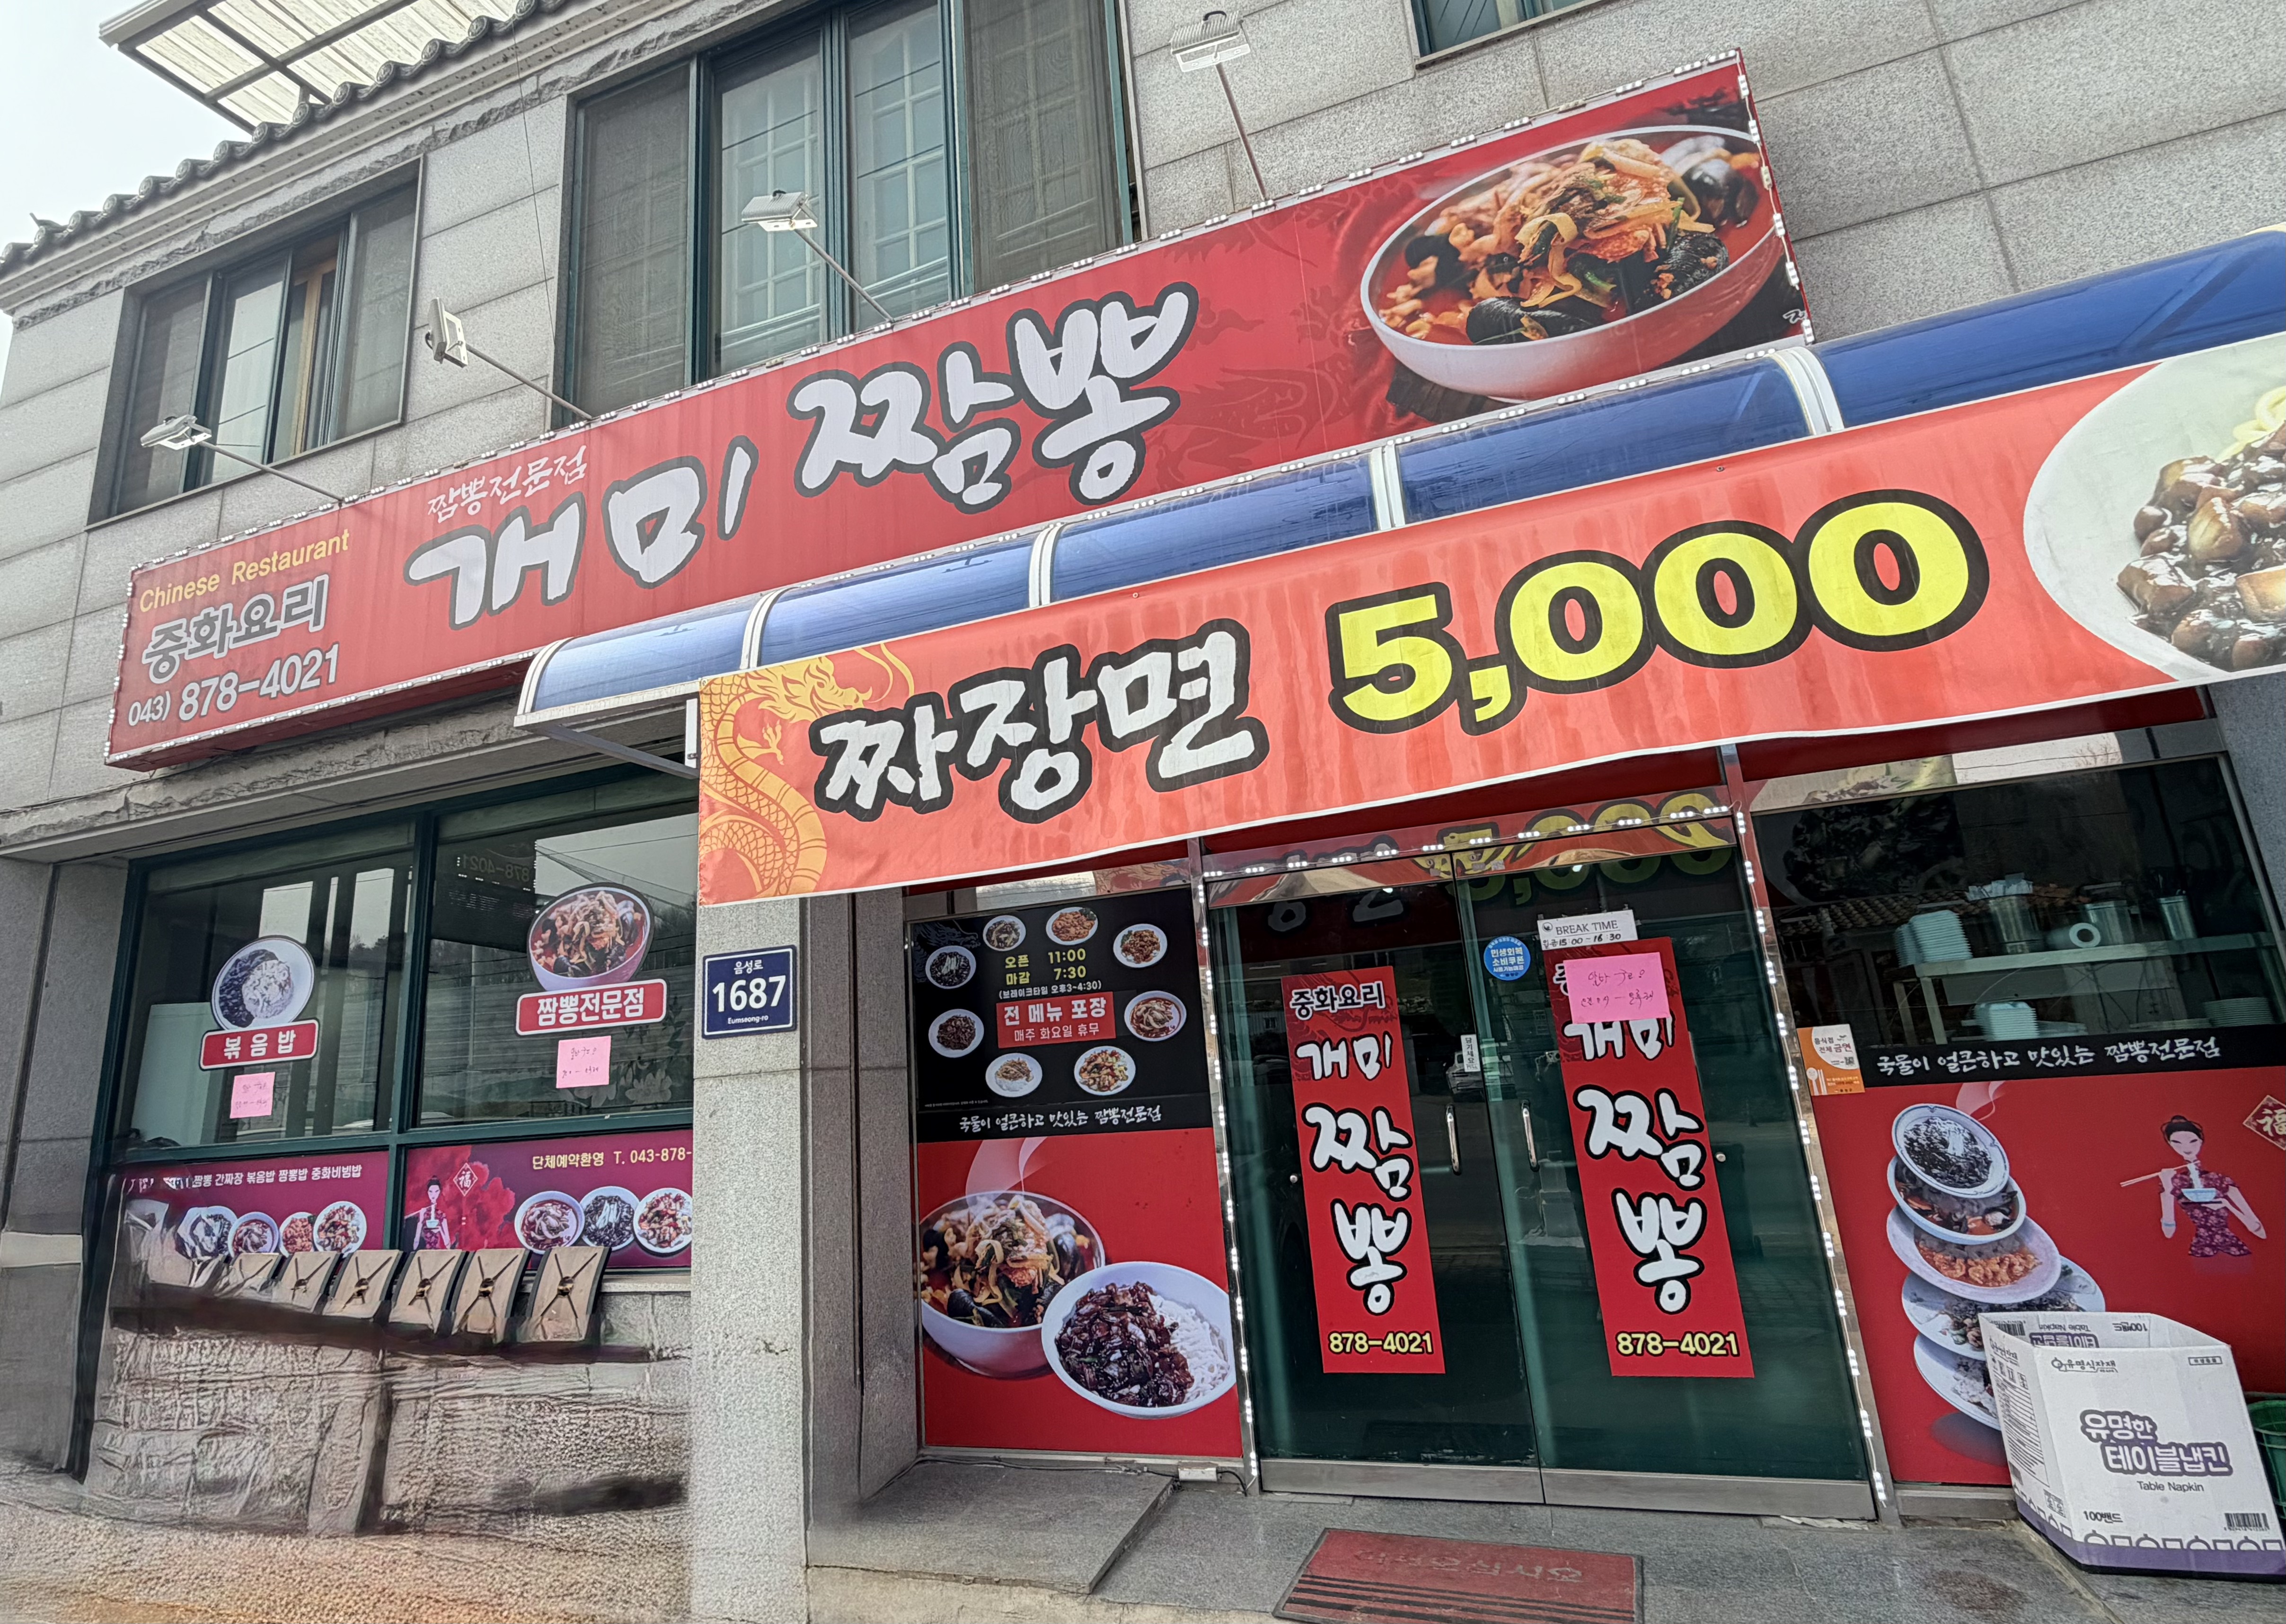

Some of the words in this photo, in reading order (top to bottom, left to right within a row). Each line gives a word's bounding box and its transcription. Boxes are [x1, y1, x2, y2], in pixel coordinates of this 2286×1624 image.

[406, 437, 757, 628] 개미
[788, 282, 1198, 512] 짬뽕
[427, 445, 587, 523] 짬뽕전문점
[140, 572, 220, 612] Chinese
[231, 528, 349, 585] Restaurant
[142, 574, 329, 684] 중화요리
[809, 619, 1269, 823] 짜장면
[1326, 490, 1989, 735] 5,000
[128, 691, 171, 726] 043)
[179, 643, 340, 721] 878-4021
[1555, 923, 1590, 935] BREAK
[1591, 920, 1618, 931] TIME
[734, 959, 764, 974] 음성로
[1005, 954, 1029, 968] 오픈
[1048, 948, 1086, 964] 11:00
[1492, 956, 1525, 966] 소비쿠폰
[1006, 971, 1030, 985] 마감
[1053, 966, 1086, 981] 7:30
[712, 975, 786, 1012] 1687
[999, 986, 1048, 1000] (브레이크타임
[1289, 980, 1386, 1020] 중화요리
[537, 987, 644, 1027] 짬뽕전문점
[727, 1015, 769, 1025] Eumseong-ro
[1004, 1005, 1020, 1026] 전
[1028, 1002, 1063, 1023] 메뉴
[1071, 997, 1106, 1019] 포장
[224, 1030, 296, 1060] 볶음밥
[1014, 1028, 1035, 1042] 매주
[1040, 1024, 1073, 1040] 화요일
[1077, 1022, 1100, 1036] 휴무
[1814, 1037, 1834, 1045] 음식점
[1296, 1031, 1394, 1081] 개미
[1834, 1043, 1853, 1053] 금연
[1877, 1053, 1931, 1076] 국물이
[1938, 1050, 2021, 1073] 얼큰하고
[2028, 1045, 2096, 1068] 맛있는
[2104, 1036, 2222, 1063] 짬뽕전문점
[959, 1115, 990, 1133] 국물이
[996, 1113, 1045, 1131] 얼큰하고
[1049, 1109, 1089, 1127] 맛있는
[1094, 1105, 1161, 1125] 짬뽕전문점
[532, 1152, 604, 1170] 단체예약환영
[613, 1151, 625, 1165] T.
[215, 1172, 244, 1186] 간짜장
[247, 1170, 275, 1184] 볶음밥
[311, 1164, 362, 1180] 중화비빔밥
[458, 1170, 471, 1188] 福
[1302, 1102, 1412, 1316] 짬뽕
[1573, 1084, 1708, 1315] 짬뽕
[2068, 1324, 2092, 1332] Table
[1328, 1332, 1433, 1355] 878-4021
[1615, 1331, 1739, 1358] 878-4021
[2067, 1359, 2116, 1370] 유명식자재
[2084, 1413, 2154, 1440] 유명한
[2104, 1445, 2230, 1473] 테이블냅킨
[2137, 1481, 2165, 1491] Table
[2168, 1482, 2205, 1493] Napkin
